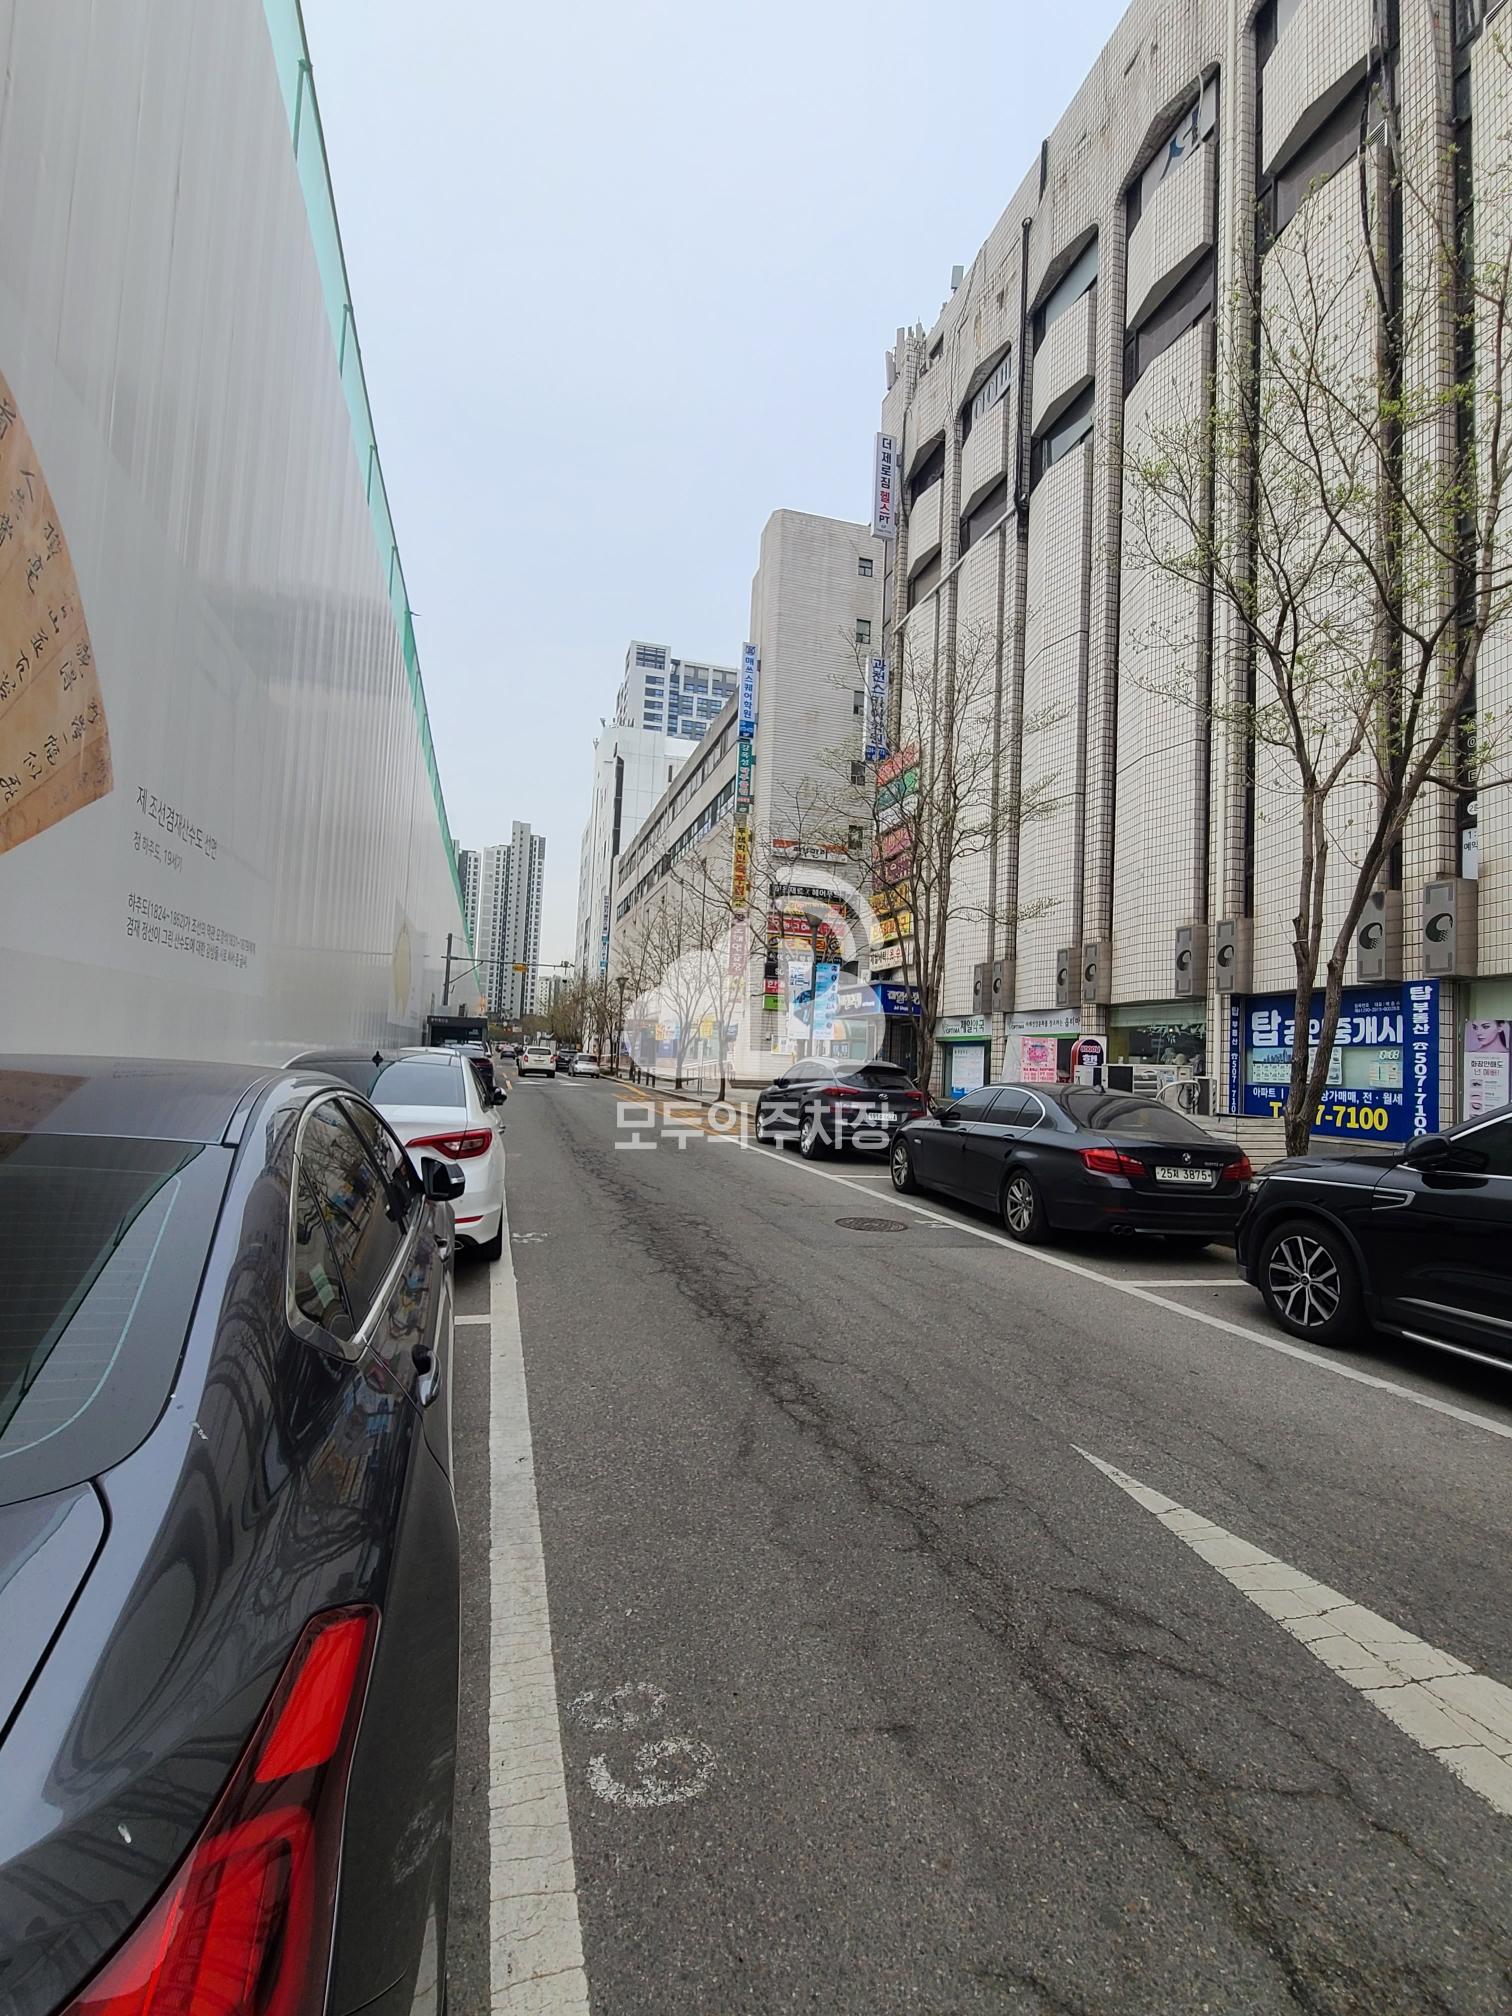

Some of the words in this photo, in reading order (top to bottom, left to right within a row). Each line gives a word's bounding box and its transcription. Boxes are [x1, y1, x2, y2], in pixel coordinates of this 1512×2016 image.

[1410, 985, 1433, 1001] 탑
[1412, 1002, 1431, 1035] 부동산
[960, 1019, 985, 1034] 제일약국
[1251, 1009, 1281, 1046] 탑
[1252, 1087, 1276, 1099] 아파트
[1183, 1168, 1207, 1181] 3875
